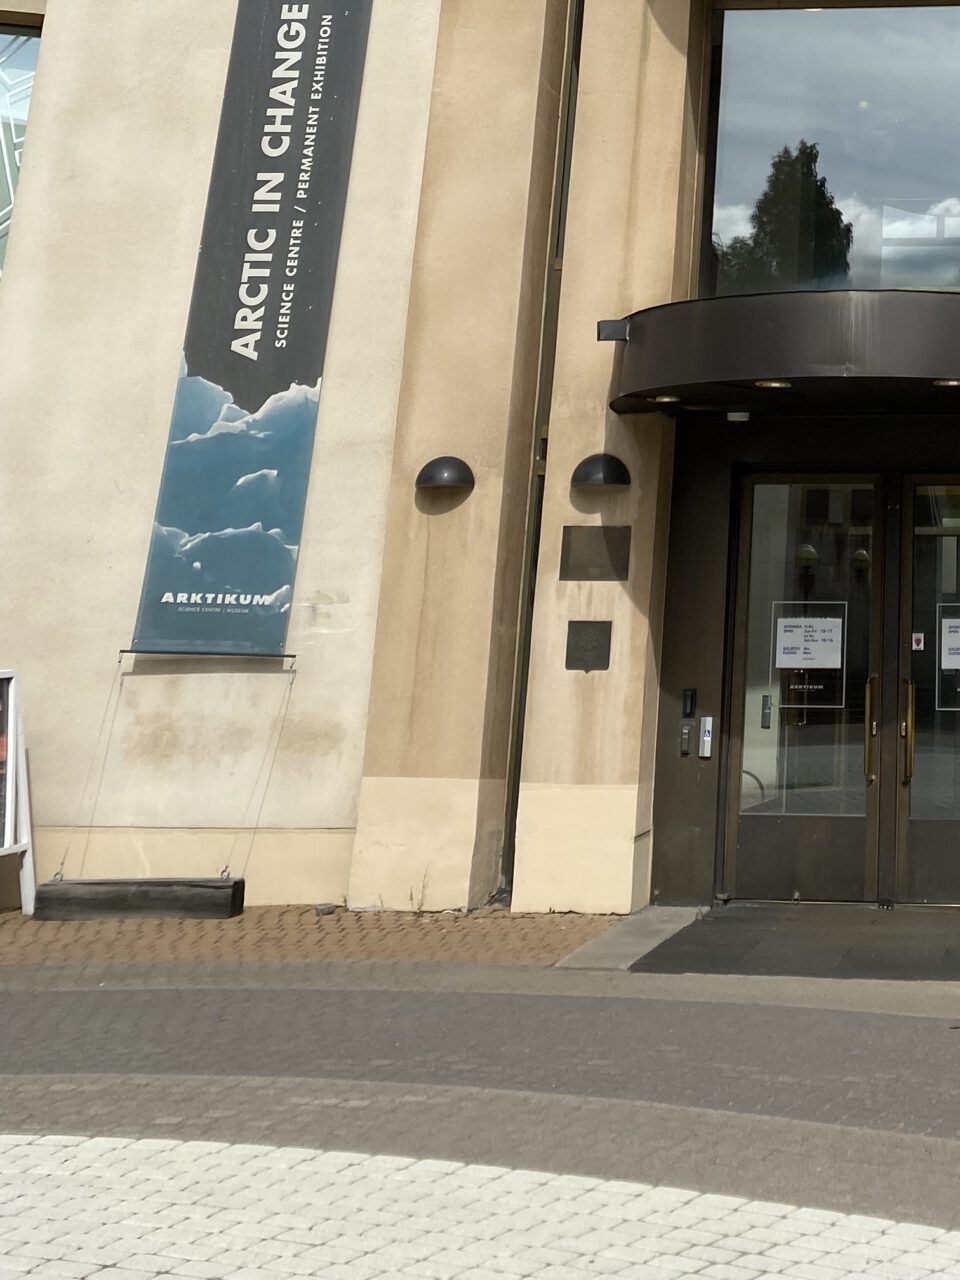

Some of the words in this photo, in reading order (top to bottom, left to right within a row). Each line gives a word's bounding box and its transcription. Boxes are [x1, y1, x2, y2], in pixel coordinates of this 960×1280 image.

[260, 4, 309, 157] CHANGE
[251, 172, 285, 212] IN
[275, 283, 295, 348] SCIENCE
[285, 220, 304, 276] CENTRE
[296, 106, 320, 198] PERMANENT
[311, 15, 333, 100] EXHIBITION
[230, 228, 277, 361] ARCTIC
[160, 592, 271, 605] ARKTIKUM
